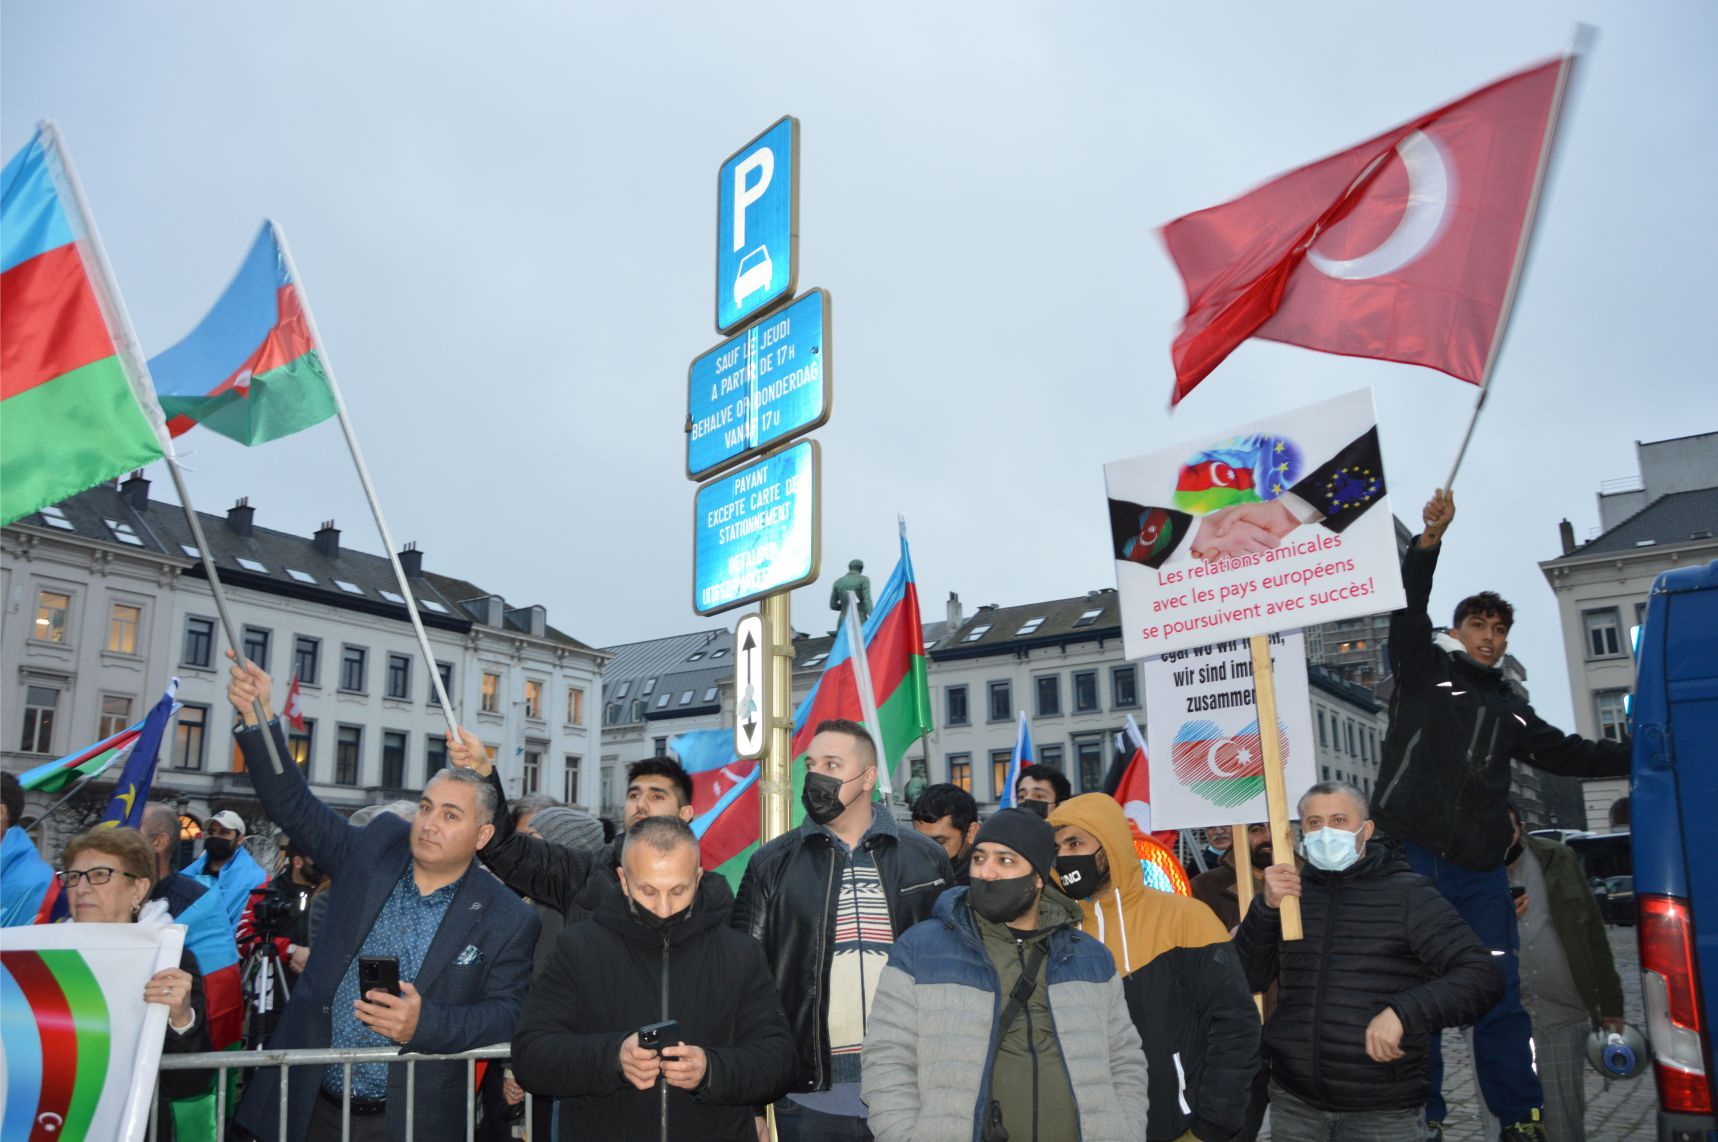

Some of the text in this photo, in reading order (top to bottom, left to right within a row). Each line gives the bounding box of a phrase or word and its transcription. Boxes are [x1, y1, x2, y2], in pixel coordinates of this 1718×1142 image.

[734, 146, 774, 252] P
[716, 345, 740, 375] SAUF
[760, 318, 791, 349] JEUDI
[692, 361, 818, 441] BEHALVE OP DONDERDAG
[711, 384, 718, 401] A
[760, 354, 773, 375] DE
[708, 498, 745, 528] EXCEPTE
[751, 483, 780, 510] CARTE
[735, 466, 768, 495] PAYANT
[719, 501, 791, 544] STATIONNEMENT
[1153, 556, 1355, 612] avec les pays européens
[1158, 533, 1342, 586] Les relations amicales
[1143, 576, 1375, 639] se poursuivent avec succès!
[1174, 667, 1194, 687] wir
[1199, 661, 1227, 684] sind
